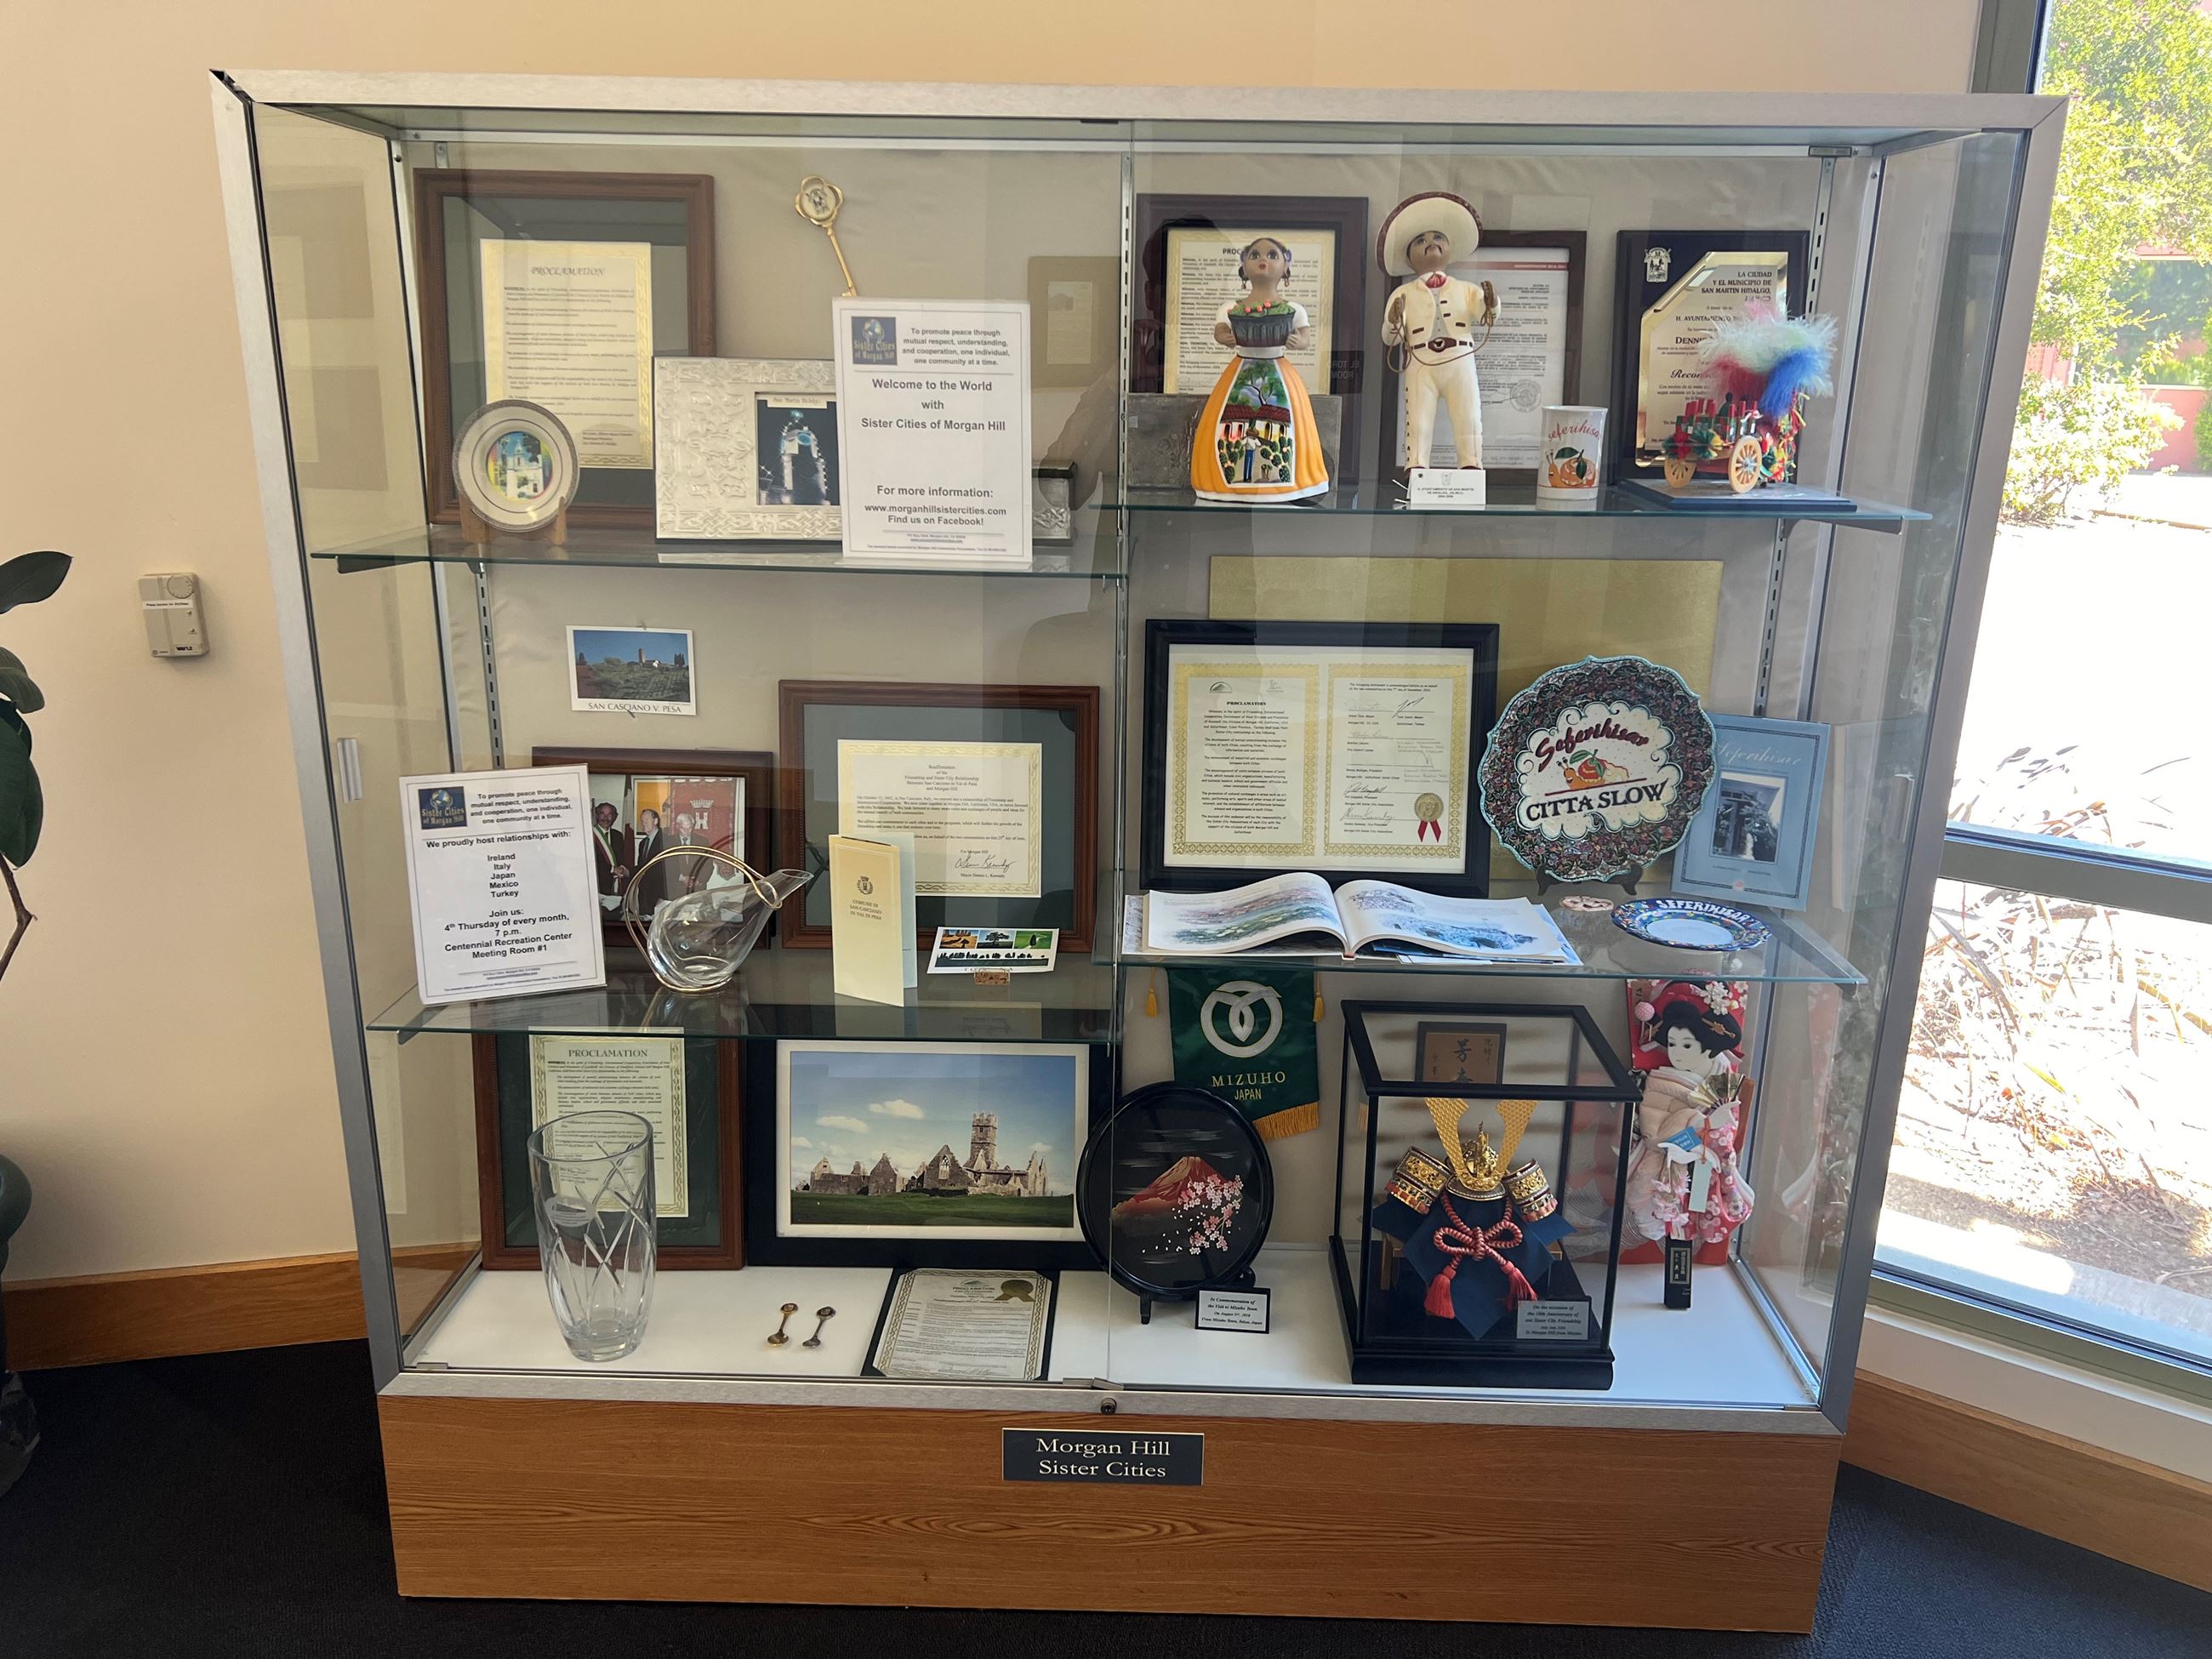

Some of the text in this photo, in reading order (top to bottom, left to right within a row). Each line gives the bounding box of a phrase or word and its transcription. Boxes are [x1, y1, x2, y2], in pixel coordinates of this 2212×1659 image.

[532, 266, 605, 276] PROCLAMATION
[854, 340, 895, 351] Sister Cities
[872, 379, 992, 391] Welcome to the World
[921, 400, 944, 409] with
[861, 418, 1006, 432] Sister Cities of Morgan Hill
[877, 485, 993, 498] For more information:
[864, 505, 1006, 516] www.morganhillsistercities.com
[888, 515, 908, 524] Find
[938, 516, 983, 526] Facebook!
[607, 703, 651, 711] CASCIANO
[1536, 717, 1649, 772] Seferihisar
[522, 796, 570, 805] understanding,
[1526, 778, 1668, 821] CITTA SLOW
[422, 808, 442, 818] Sister
[484, 808, 525, 817] cooperation,
[431, 817, 452, 826] Morgan
[496, 815, 532, 824] community
[442, 837, 474, 848] proudly
[497, 832, 550, 843] relationships
[1656, 899, 1750, 924] SEFERIHISAR
[444, 923, 455, 932] 4th
[458, 920, 499, 931] Thursday
[513, 917, 537, 926] every
[539, 913, 569, 922] month,
[503, 929, 522, 938] p.m.
[445, 941, 492, 952] Centennial
[494, 935, 542, 946] Recreation
[472, 949, 507, 959] Meeting
[568, 1049, 647, 1058] PROCLAMATION
[1211, 1071, 1286, 1087] MIZUHO
[1234, 1088, 1262, 1100] JAPAN
[1035, 1438, 1171, 1458] Morgan Hill
[1039, 1460, 1166, 1478] Sister Cities
